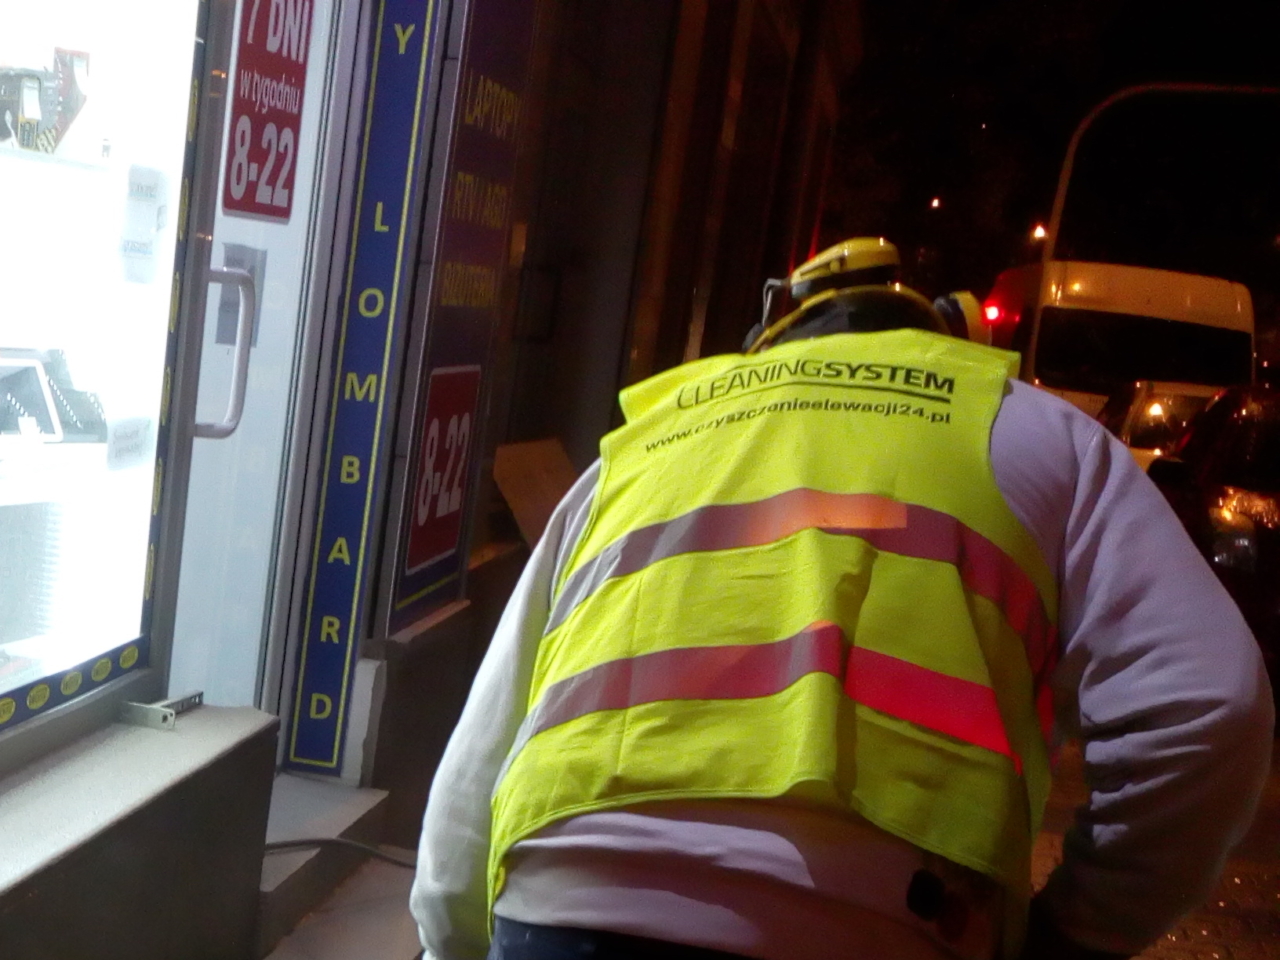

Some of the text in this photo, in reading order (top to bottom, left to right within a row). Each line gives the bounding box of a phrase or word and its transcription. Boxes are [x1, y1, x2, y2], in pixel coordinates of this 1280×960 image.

[266, 0, 312, 64] DNI
[240, 69, 301, 115] w tygodniu
[230, 115, 294, 208] 8-22
[309, 202, 389, 719] LOMBARD
[418, 413, 470, 526] 8-22
